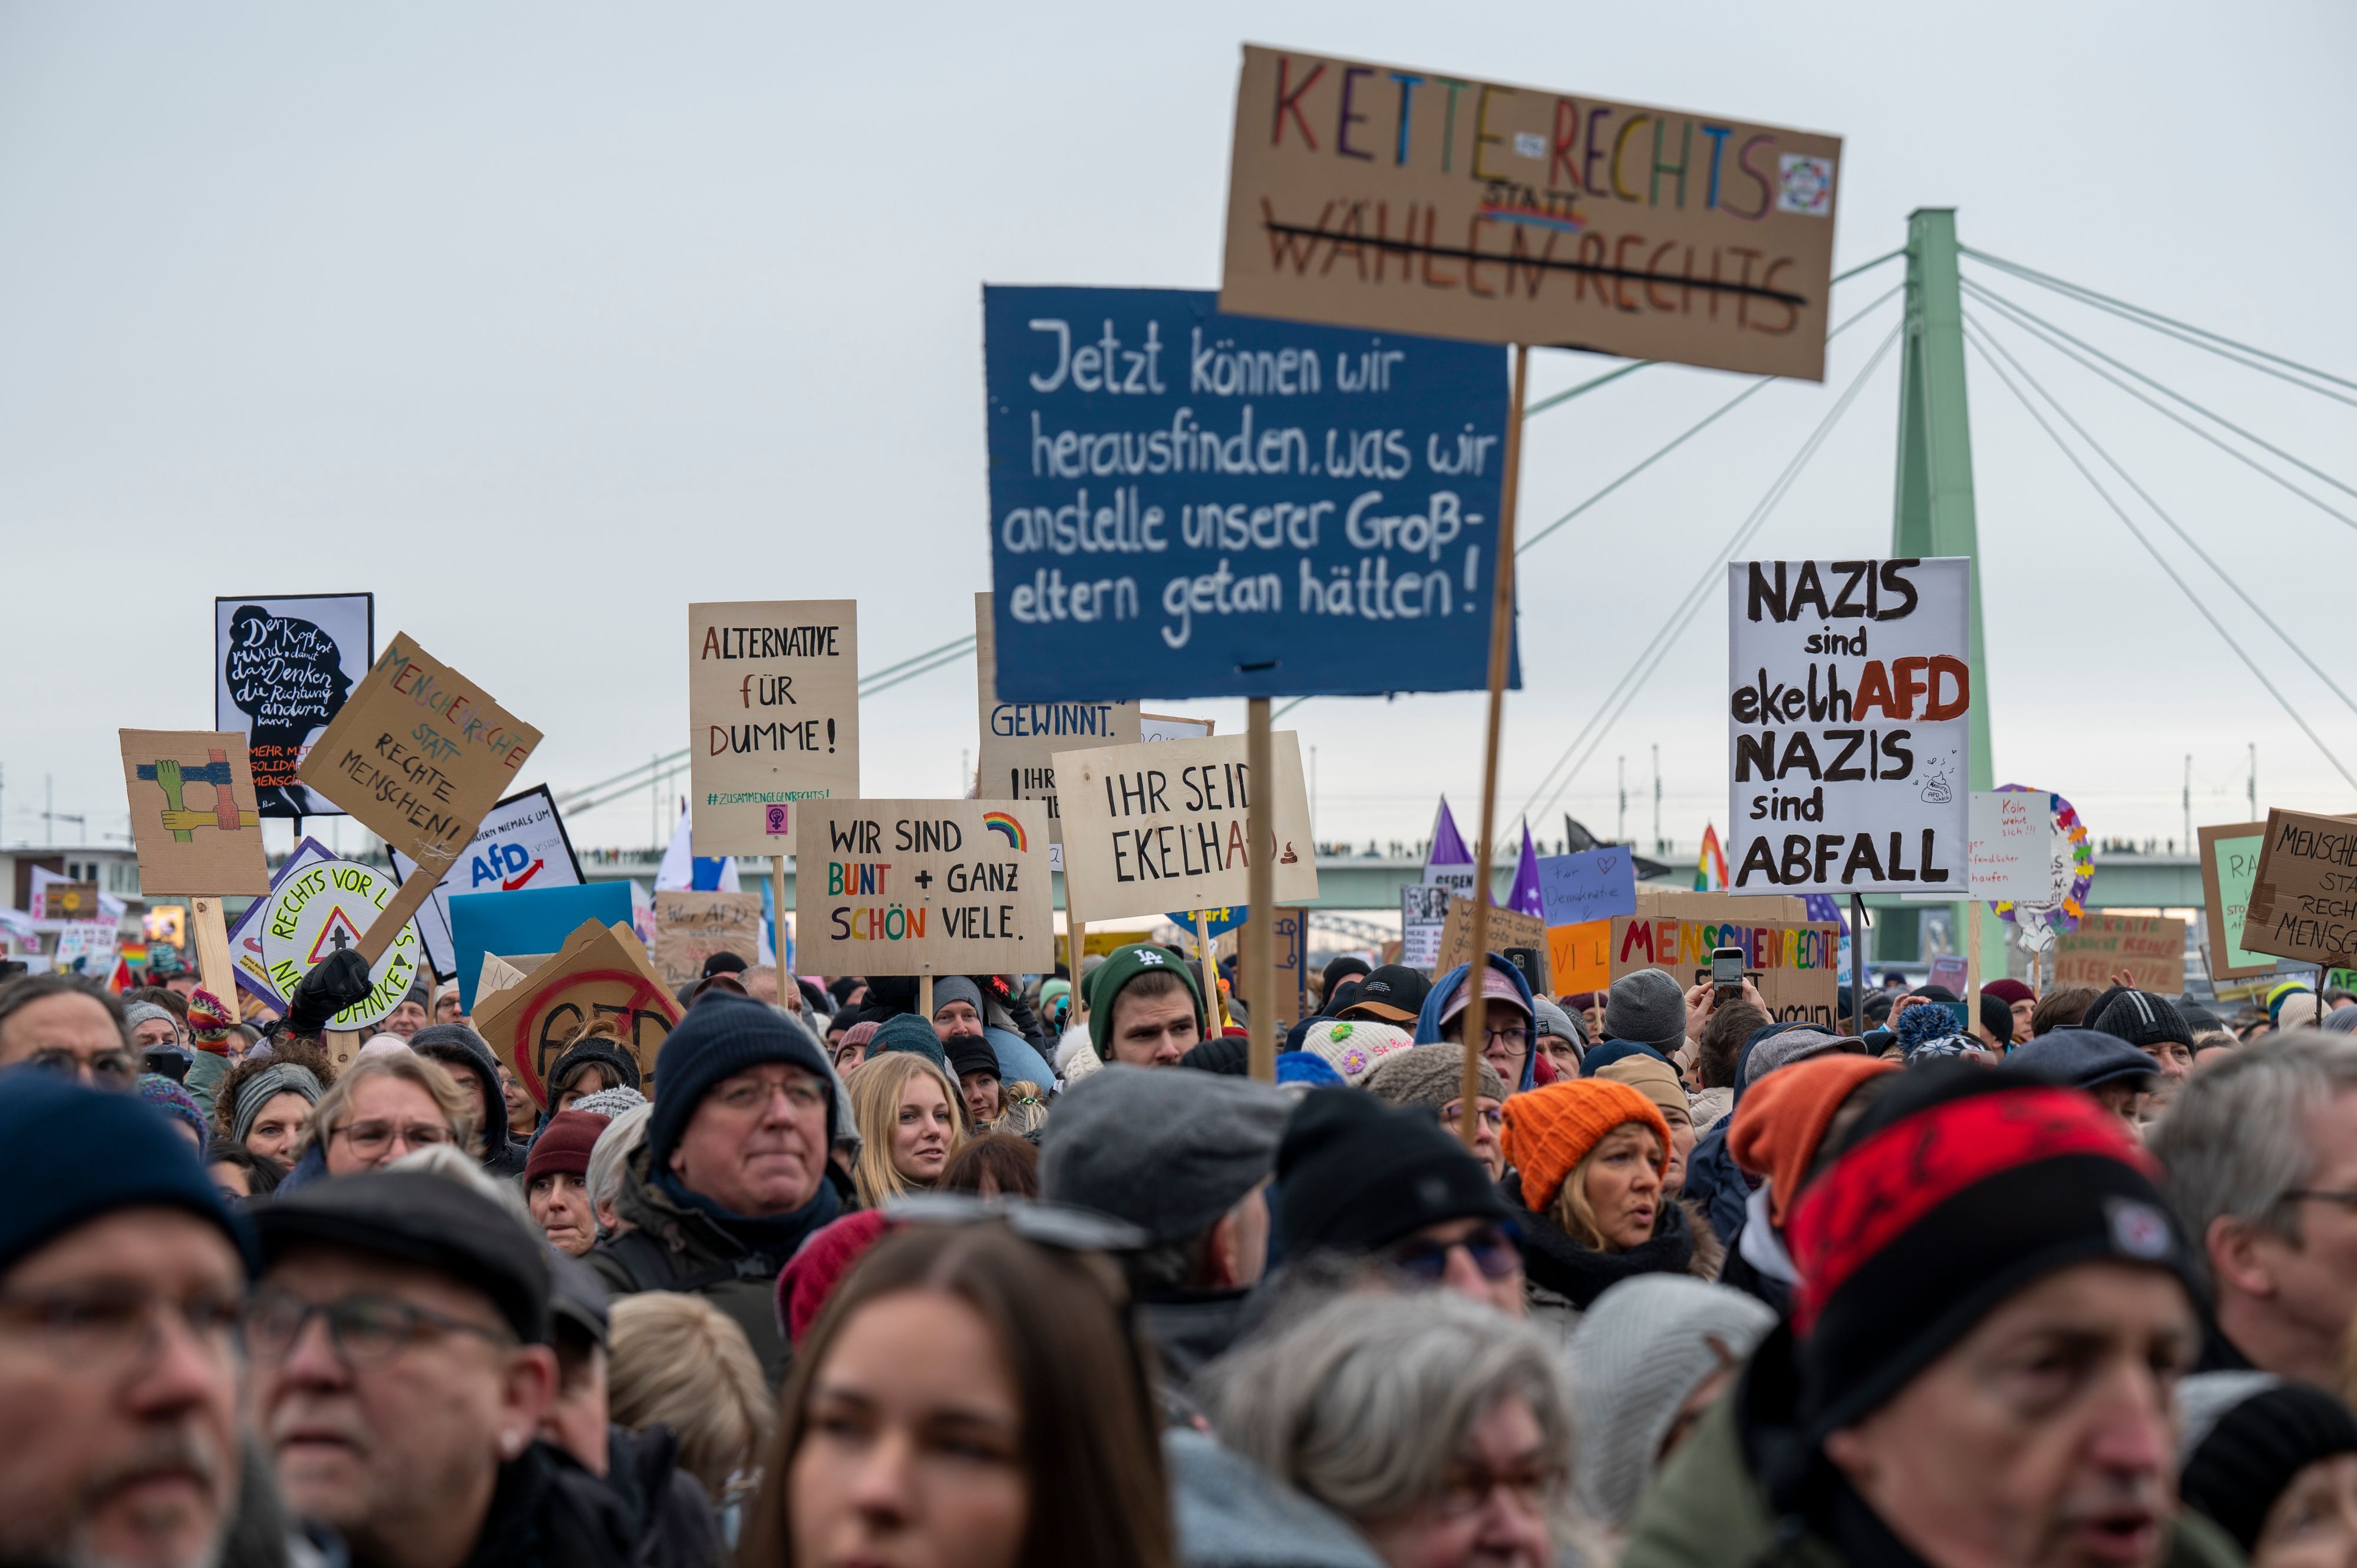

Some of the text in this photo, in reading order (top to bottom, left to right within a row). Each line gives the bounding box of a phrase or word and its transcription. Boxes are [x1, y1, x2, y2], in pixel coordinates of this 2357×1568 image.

[1272, 55, 1776, 222] KETTE RECHTS
[1483, 179, 1581, 219] STATT
[1260, 197, 1801, 338] WÄHLEN RECHTS
[1029, 318, 1405, 395] Jetzt können wir
[1327, 427, 1412, 480] was
[1428, 424, 1498, 477] wir
[1002, 485, 1484, 563] anstelle unserer Groß-
[1009, 544, 1481, 647] eltern getan hätten!
[1748, 558, 1920, 623] NAZIS
[241, 618, 332, 653] Der Kopf ist
[291, 644, 318, 661] damit
[702, 626, 839, 660] ALTERNATIVE
[1804, 625, 1867, 656] sind
[232, 658, 332, 688] das Denken
[1731, 654, 1969, 725] ekelhAFD
[236, 679, 334, 704] die Richtung
[261, 699, 329, 717] ändern
[377, 646, 527, 768] MENSCHENRECHTE
[258, 715, 292, 728] kann.
[711, 718, 836, 757] DUMME!
[249, 745, 312, 757] MEHR MIT
[412, 723, 462, 763] STATT
[1735, 729, 1913, 783] NAZIS
[251, 760, 302, 771] SOLIDAR
[375, 733, 457, 804] RECHTE
[1025, 768, 1055, 789] IHR
[339, 749, 461, 850] MENSCHEN!
[707, 789, 830, 806] #ZUSAMMENGEGENRECHTS!
[1105, 763, 1251, 817] IHR SEID
[1749, 786, 1824, 823] sind
[2002, 798, 2025, 814] Köln
[470, 809, 550, 844] AUERN NIEMALS UM
[830, 820, 962, 854] WIR SIND
[2002, 816, 2026, 826] wehrt
[2002, 826, 2022, 836] sich
[1112, 820, 1277, 883] EKELHA
[1735, 828, 1949, 887] ABFALL
[1969, 841, 1984, 854] ger
[1969, 854, 2018, 865] feindlicher
[2276, 824, 2357, 867] MENSCHE
[828, 862, 1018, 896] BUNT + GANZ
[1436, 875, 1474, 887] GEGEN
[2230, 854, 2257, 879] RA
[2319, 873, 2357, 893] STA
[272, 869, 326, 940] RECHTS
[332, 869, 372, 897] VOR
[1544, 884, 1619, 906] Demokratie
[2227, 905, 2246, 916] STO
[2298, 895, 2357, 920] RECH
[831, 903, 1024, 940] SCHÖN VIELE.
[1187, 907, 1231, 922] sark
[1453, 935, 1474, 953] glau
[1488, 928, 1510, 943] ichts
[1620, 920, 1839, 970] MENSCHENRECHTE
[2275, 913, 2357, 955] MENSC
[243, 954, 255, 965] Keine
[1134, 949, 1164, 966] LA
[1554, 940, 1609, 973] VIEL
[270, 960, 303, 998] NE
[2330, 972, 2357, 989] AF
[1767, 1004, 1837, 1032] NSCHEN
